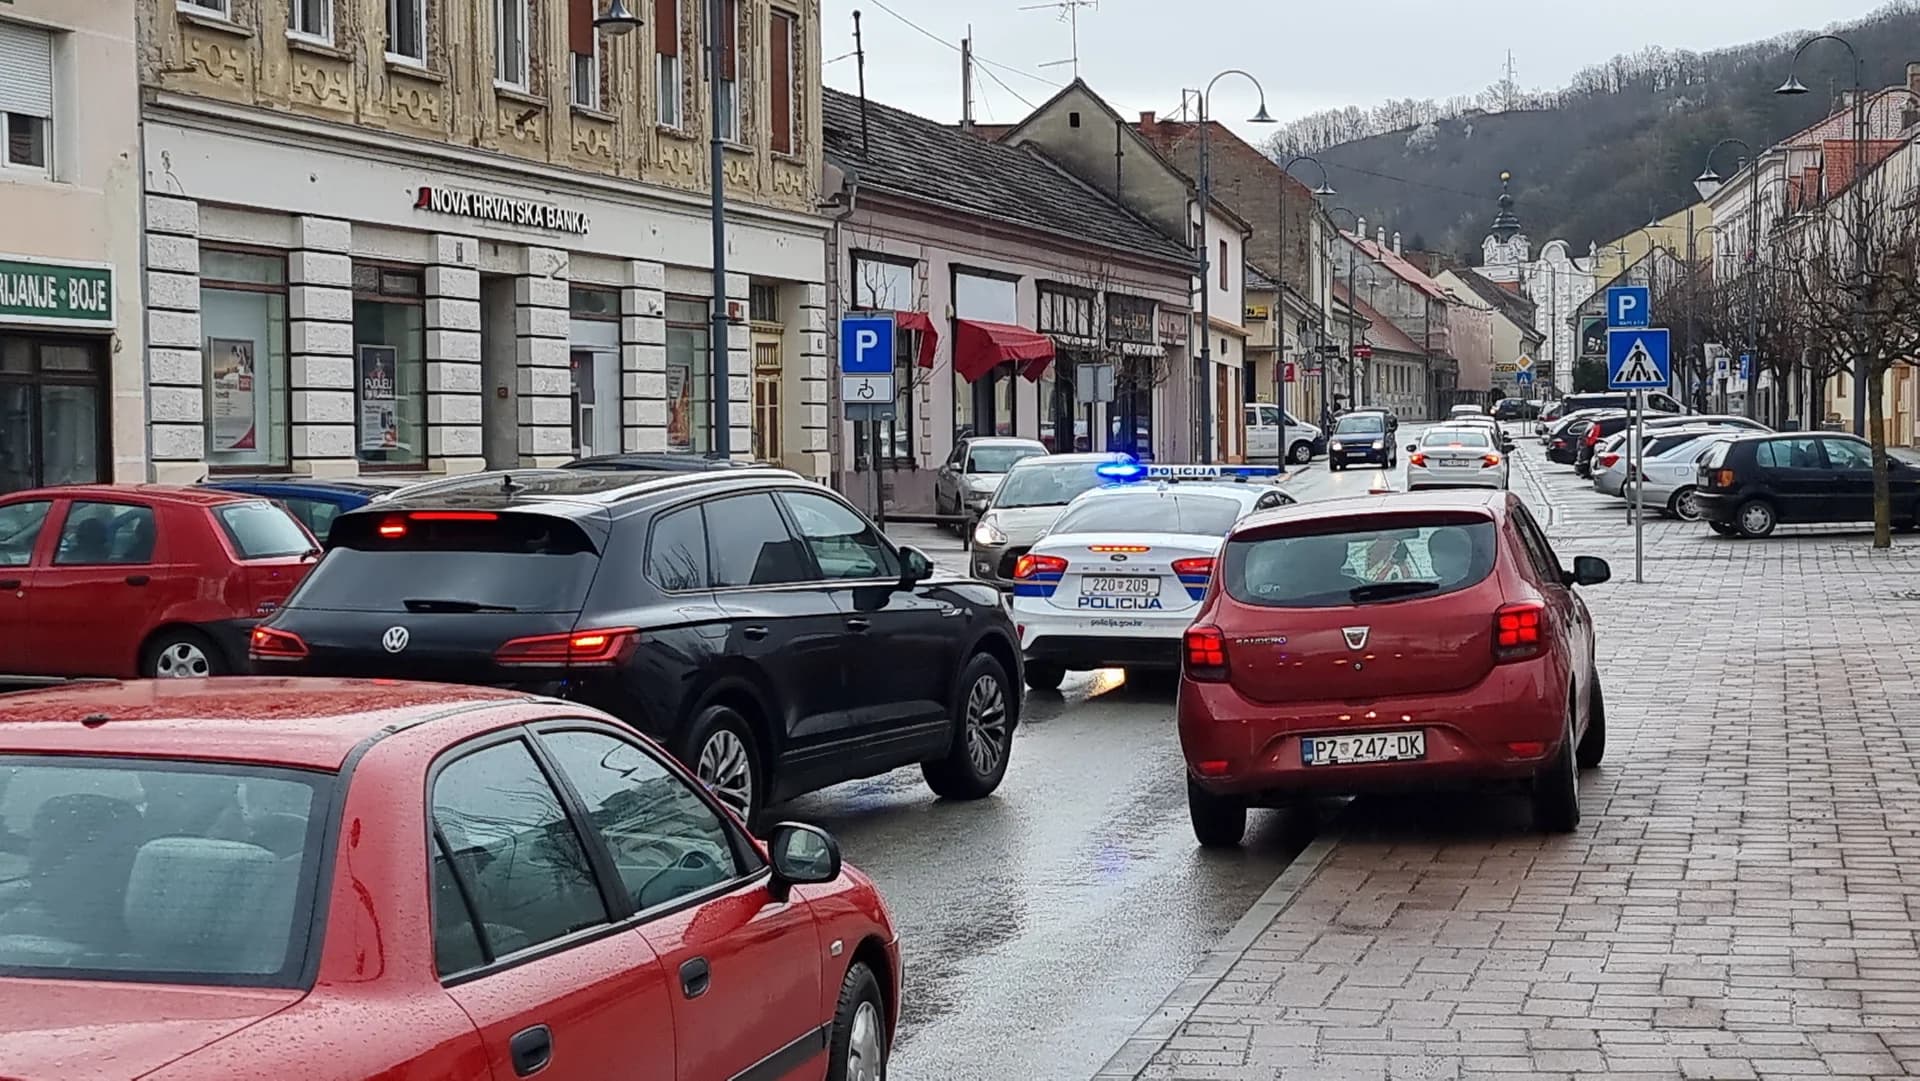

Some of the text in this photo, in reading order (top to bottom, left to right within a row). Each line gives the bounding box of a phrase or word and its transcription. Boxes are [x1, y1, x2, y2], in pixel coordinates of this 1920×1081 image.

[430, 188, 591, 235] NOVA HRVATSKA BANKA
[69, 277, 107, 312] BOJE
[1618, 295, 1637, 319] P
[856, 329, 878, 363] P
[1150, 466, 1217, 476] POLICIJA
[1092, 578, 1149, 592] 220 209
[1078, 596, 1162, 610] POLICIJA
[1315, 740, 1338, 760] PZ
